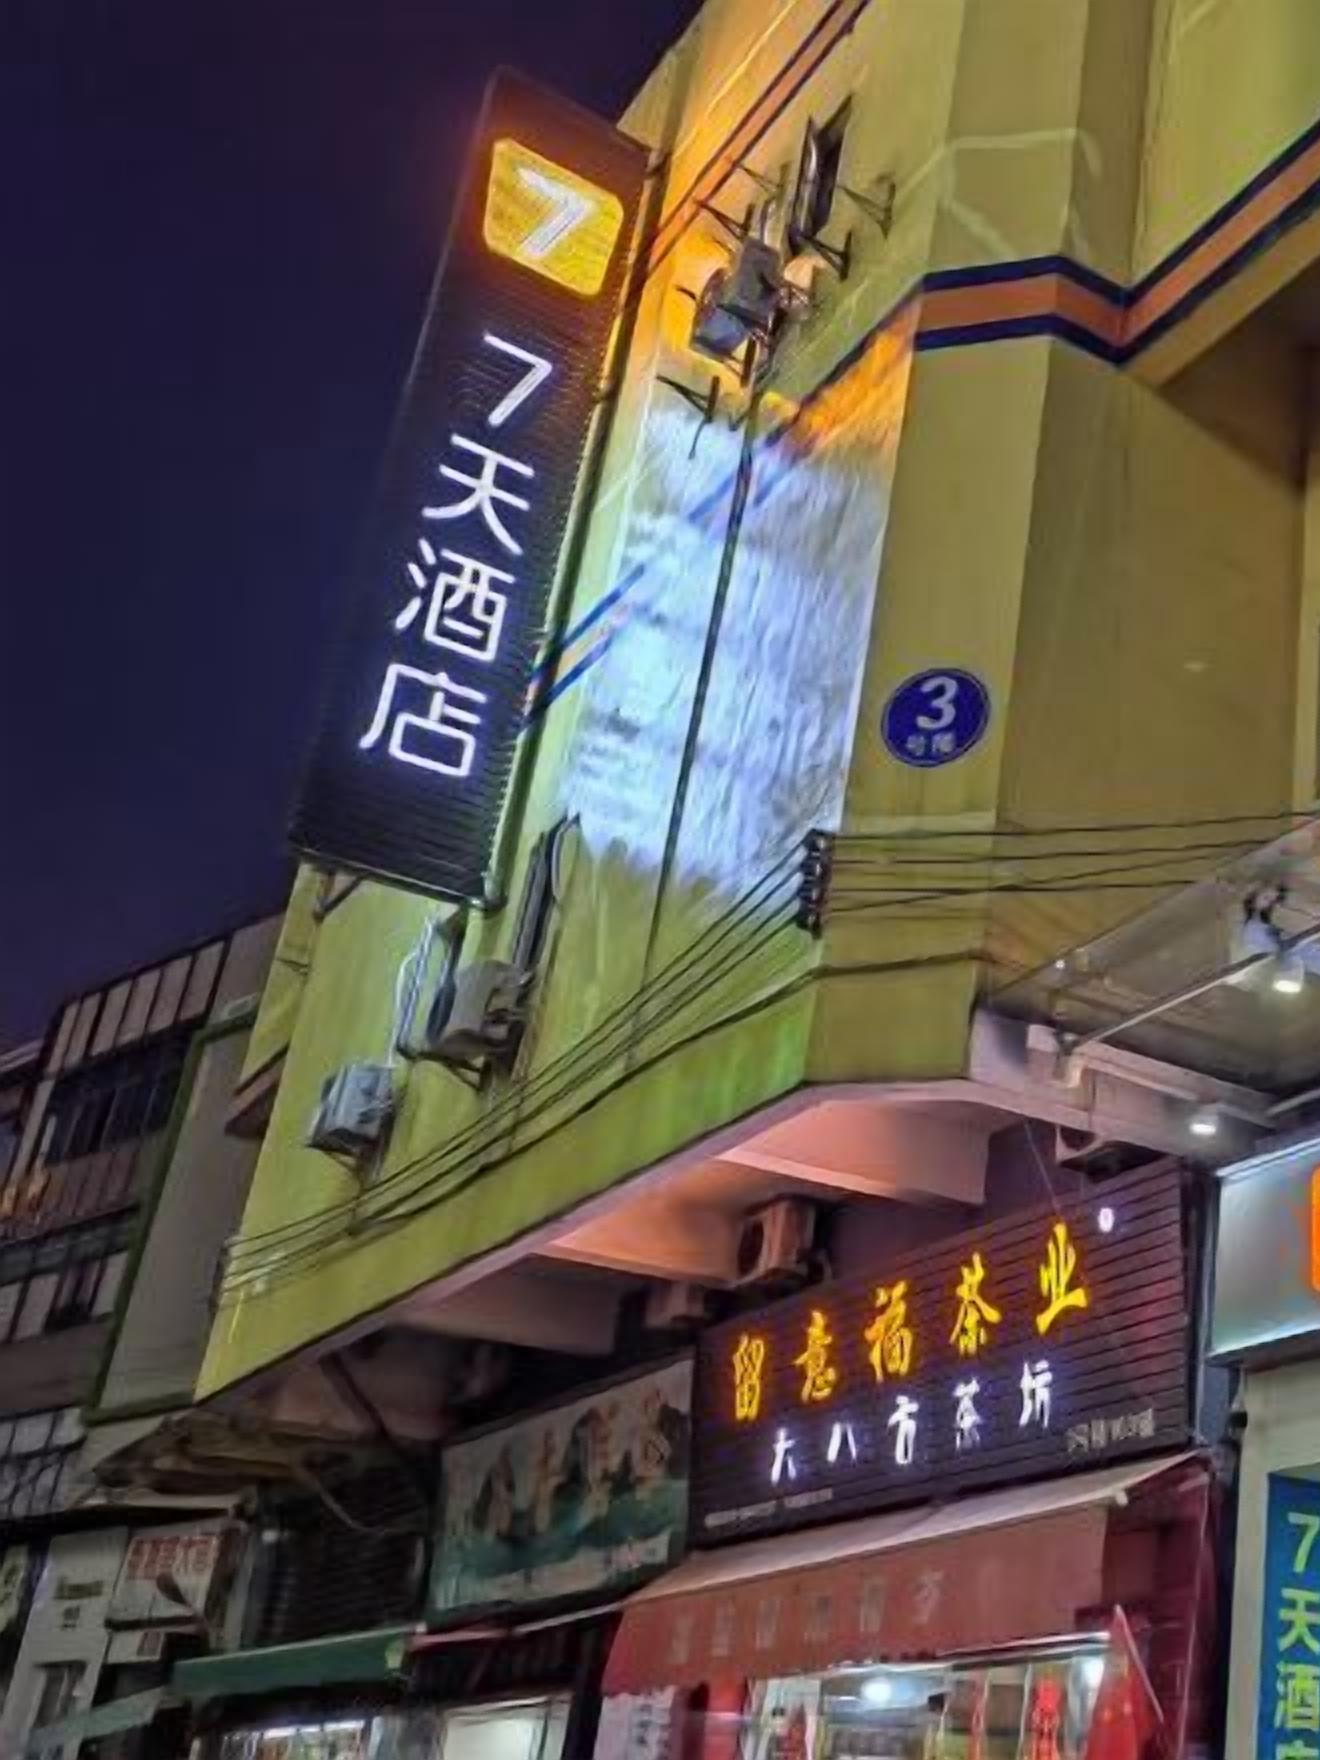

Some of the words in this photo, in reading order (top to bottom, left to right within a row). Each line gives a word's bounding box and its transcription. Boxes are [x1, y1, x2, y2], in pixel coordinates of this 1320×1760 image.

[516, 166, 596, 260] 7
[359, 332, 552, 779] 7天酒店
[916, 676, 958, 729] 3
